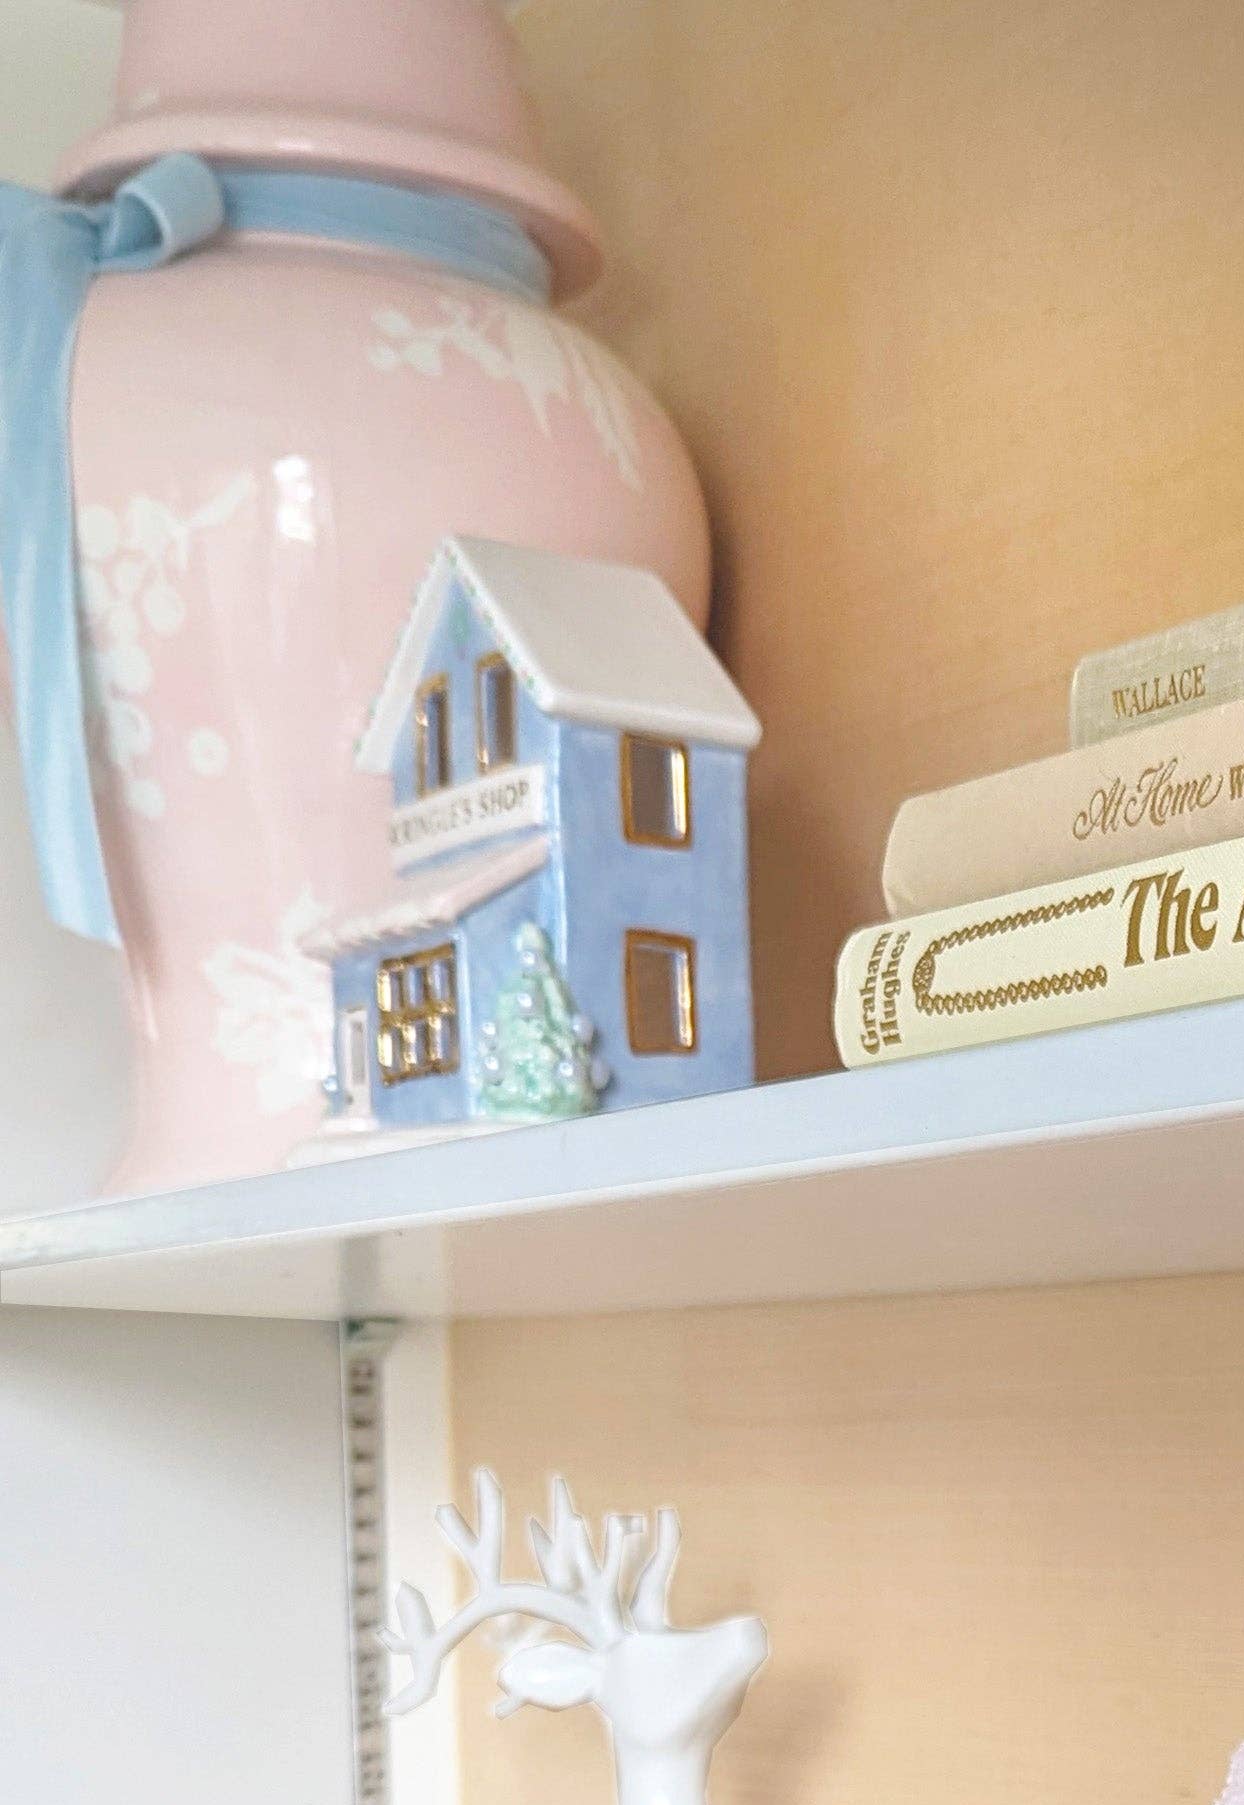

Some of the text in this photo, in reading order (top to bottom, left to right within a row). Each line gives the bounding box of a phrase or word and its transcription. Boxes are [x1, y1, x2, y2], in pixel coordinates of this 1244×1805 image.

[1111, 664, 1207, 719] WALLACE
[1072, 774, 1128, 841] At
[1124, 757, 1224, 827] Home
[1119, 867, 1219, 968] The
[859, 931, 894, 1056] Graham
[879, 930, 912, 1047] Hughes
